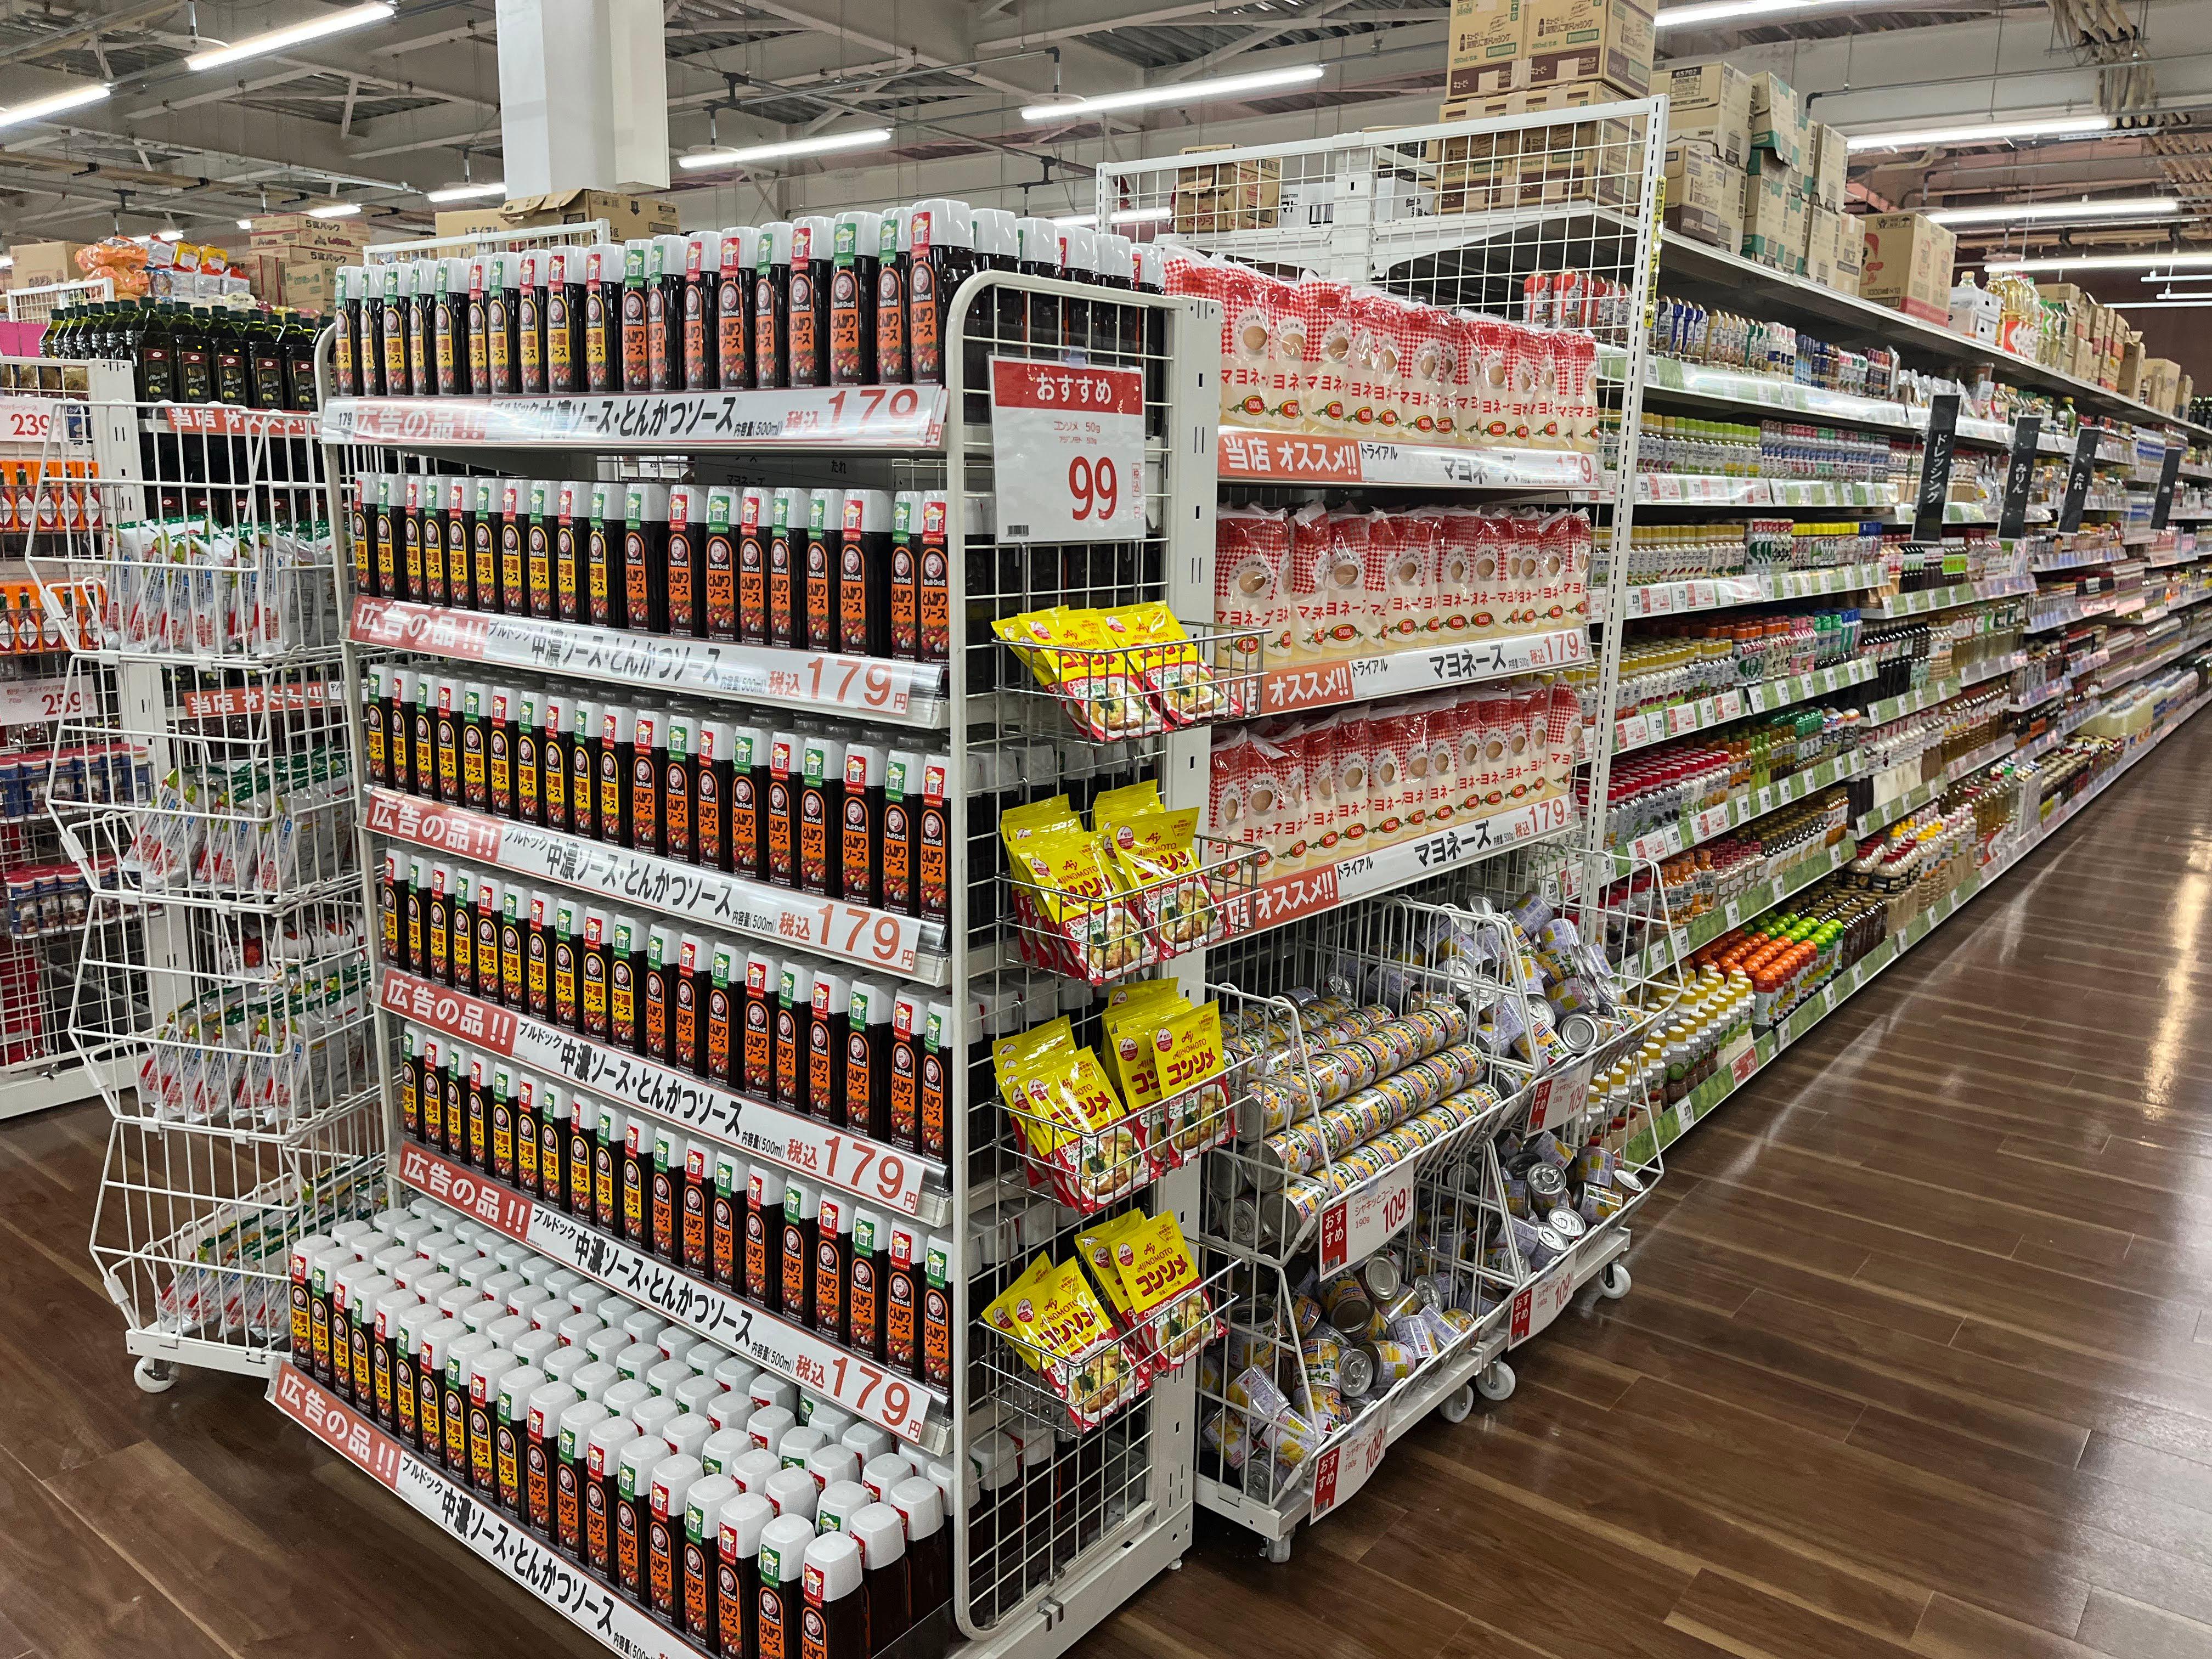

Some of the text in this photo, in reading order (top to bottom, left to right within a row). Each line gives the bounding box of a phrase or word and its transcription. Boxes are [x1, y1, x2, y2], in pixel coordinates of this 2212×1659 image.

[833, 329, 855, 343] ソース
[1036, 373, 1113, 404] おすすめ
[338, 412, 352, 426] 179
[828, 389, 918, 435] 179
[1086, 422, 1101, 433] 50g
[1223, 436, 1271, 472] 当店
[1360, 443, 1398, 461] トライアル
[1440, 452, 1519, 484] マヨネズ
[1926, 433, 1948, 504] ドレッシング
[2012, 463, 2027, 494] みりん
[1069, 456, 1118, 521] 99
[709, 588, 730, 600] ソース
[922, 591, 947, 605] とんかつ
[923, 605, 946, 619] ソース
[1352, 658, 1387, 677] トライアル
[1429, 642, 1504, 679] マヨネーズ
[1544, 632, 1578, 662] 179
[1581, 647, 1587, 657] 円
[768, 670, 800, 697] 税込
[807, 657, 892, 706] 179
[894, 693, 907, 710] 円
[465, 767, 482, 778] ソース
[845, 836, 866, 849] とんかつ
[1337, 856, 1373, 879] トライアル
[1414, 820, 1492, 867] マヨネーズ
[1530, 799, 1564, 832] 179
[844, 849, 866, 862] ソース
[505, 826, 548, 851] ブルドック
[547, 836, 732, 918] 中濃ソース・とんかつソース
[779, 911, 811, 941] 税込
[817, 904, 900, 959] 179
[901, 949, 914, 967] 円
[585, 994, 602, 1007] ソース
[1173, 1038, 1207, 1059] AJINOMOTO
[1166, 1048, 1216, 1083] コンソメ
[893, 1080, 913, 1093] とんかつ
[893, 1092, 912, 1107] ソース
[520, 1022, 562, 1049] ブルドック
[561, 1039, 742, 1137] 中濃ソース・とんかつソース
[787, 1138, 817, 1171] 税込
[825, 1136, 905, 1199] 179
[904, 1191, 917, 1210] 円
[1356, 1216, 1370, 1229] 190g
[1383, 1188, 1406, 1233] 109
[1136, 1246, 1174, 1273] AJINOMOTO
[1135, 1253, 1189, 1296] コンソメ
[853, 1281, 872, 1293] Bull-Dog
[852, 1292, 873, 1307] とんかつ
[890, 1294, 911, 1307] Bull-Dog
[851, 1305, 871, 1319] ソース
[889, 1308, 911, 1323] とんかつ
[534, 1208, 575, 1241] ブルドック
[575, 1231, 753, 1347] 中濃ソース・とんかつソース
[795, 1354, 825, 1389] 税込
[832, 1356, 910, 1426] 179
[908, 1419, 921, 1439] 円
[889, 1321, 910, 1335] ソース
[472, 1449, 489, 1464] ソース
[1365, 1428, 1382, 1474] 109
[402, 1457, 442, 1494] ブルドック
[441, 1487, 615, 1637] 中濃ソース・とんかつソース
